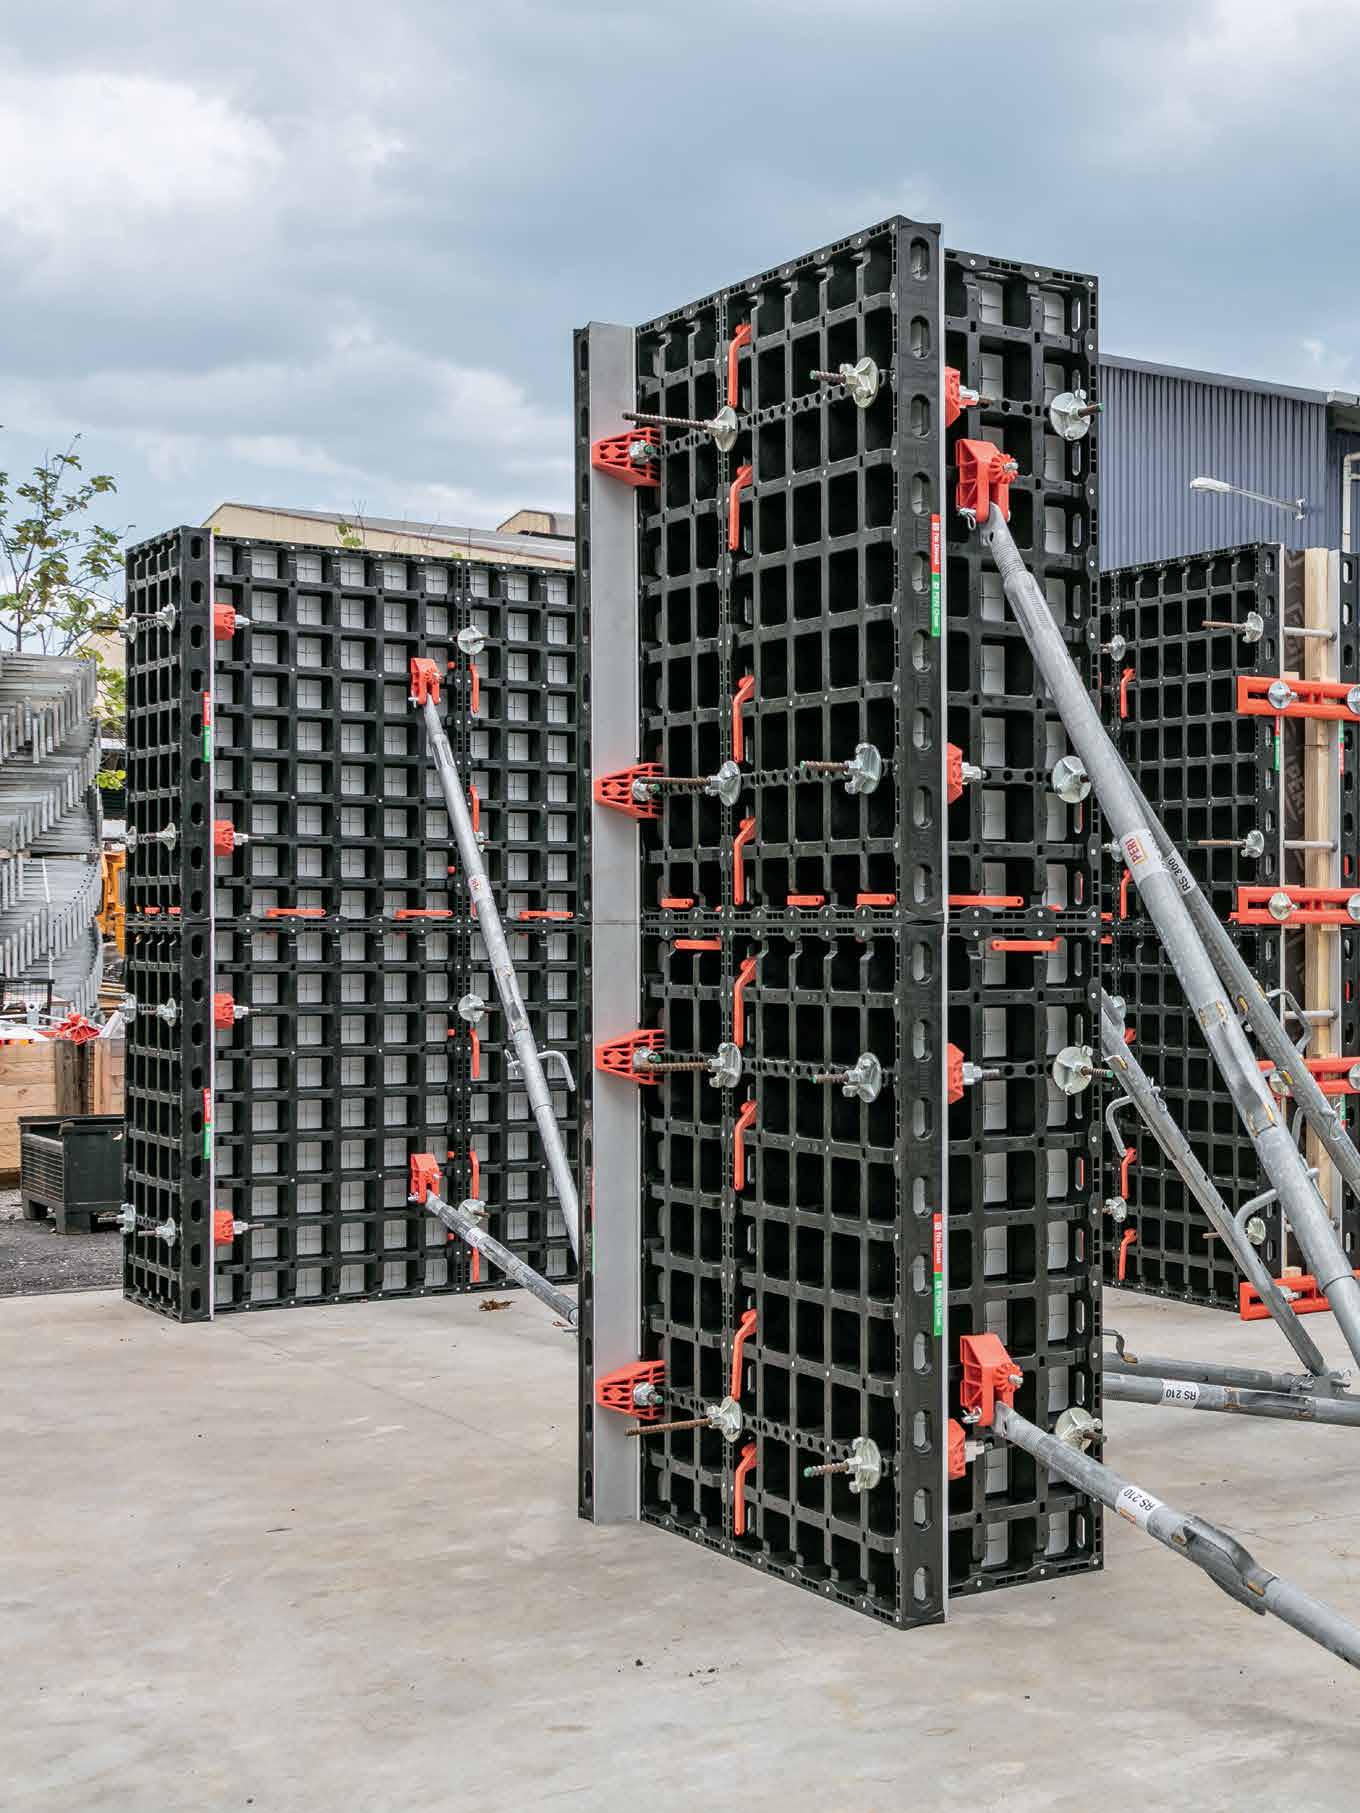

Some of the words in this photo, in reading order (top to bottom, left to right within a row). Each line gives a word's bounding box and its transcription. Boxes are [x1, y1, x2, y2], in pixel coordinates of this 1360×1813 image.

[1125, 838, 1142, 865] PERI
[1168, 857, 1182, 876] 300
[1178, 876, 1191, 891] RS
[1165, 1389, 1182, 1399] 210
[1184, 1390, 1196, 1400] RS
[1123, 1488, 1142, 1502] 210
[1139, 1499, 1155, 1511] RS
